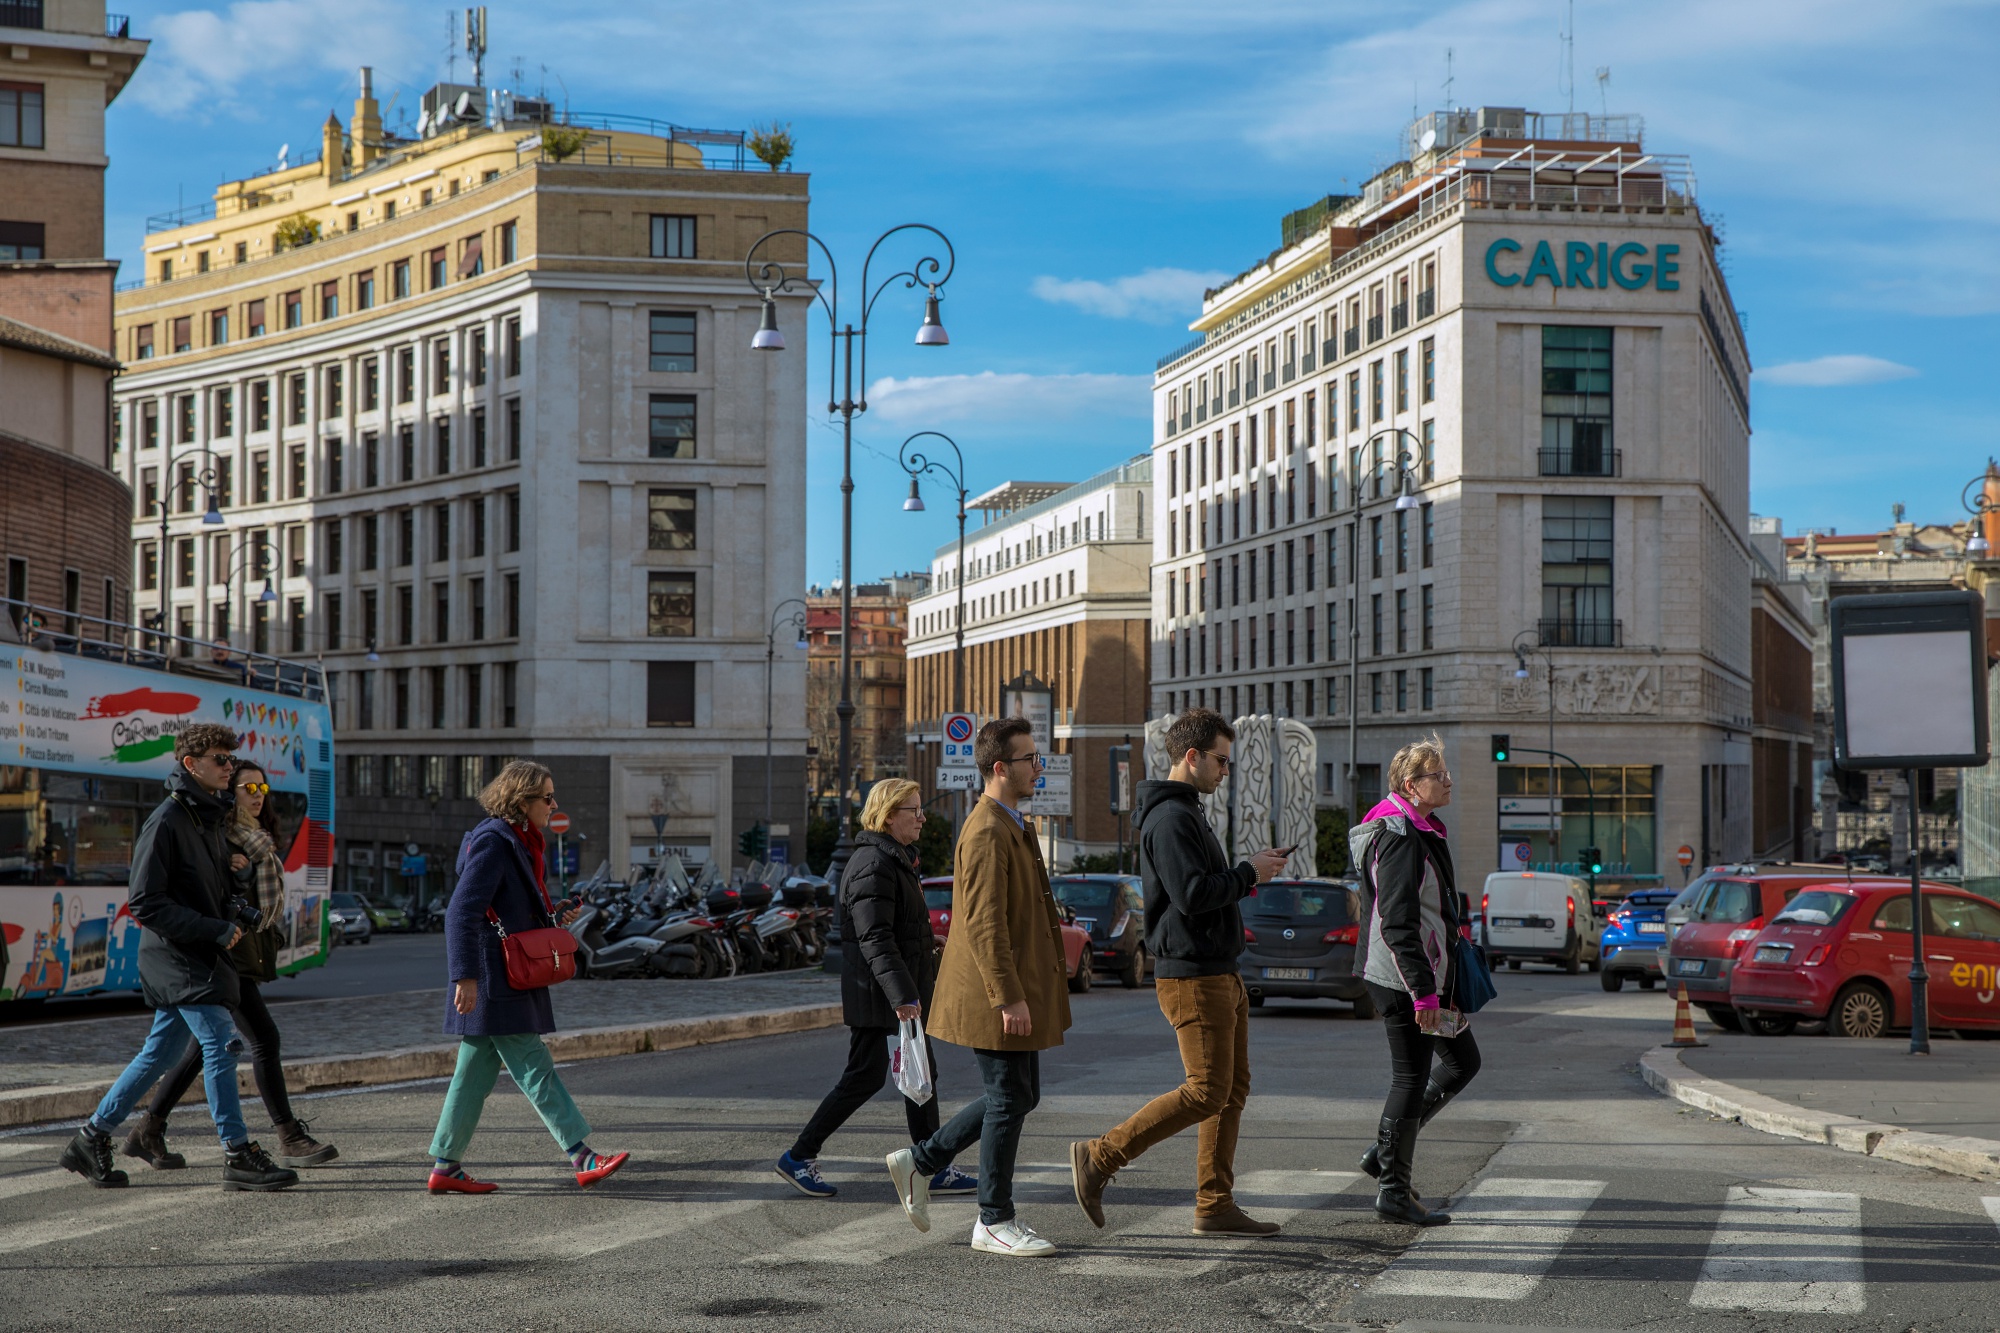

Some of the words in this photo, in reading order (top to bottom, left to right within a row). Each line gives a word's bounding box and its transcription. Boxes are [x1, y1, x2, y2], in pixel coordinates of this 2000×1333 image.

[1485, 238, 1680, 290] CARIGE
[23, 661, 36, 674] S.M.
[38, 664, 65, 679] Maggiore
[24, 681, 41, 694] Circo
[42, 684, 68, 698] Massimo
[41, 706, 51, 717] del
[52, 707, 77, 721] Vaticano
[25, 725, 36, 738] Via
[37, 727, 48, 739] Del
[48, 728, 70, 742] Tritone
[25, 746, 45, 760] Piazza
[47, 748, 74, 763] Barberini
[941, 773, 948, 781] 2
[953, 773, 976, 782] posti
[663, 847, 692, 858] BNL
[1268, 968, 1279, 979] FN
